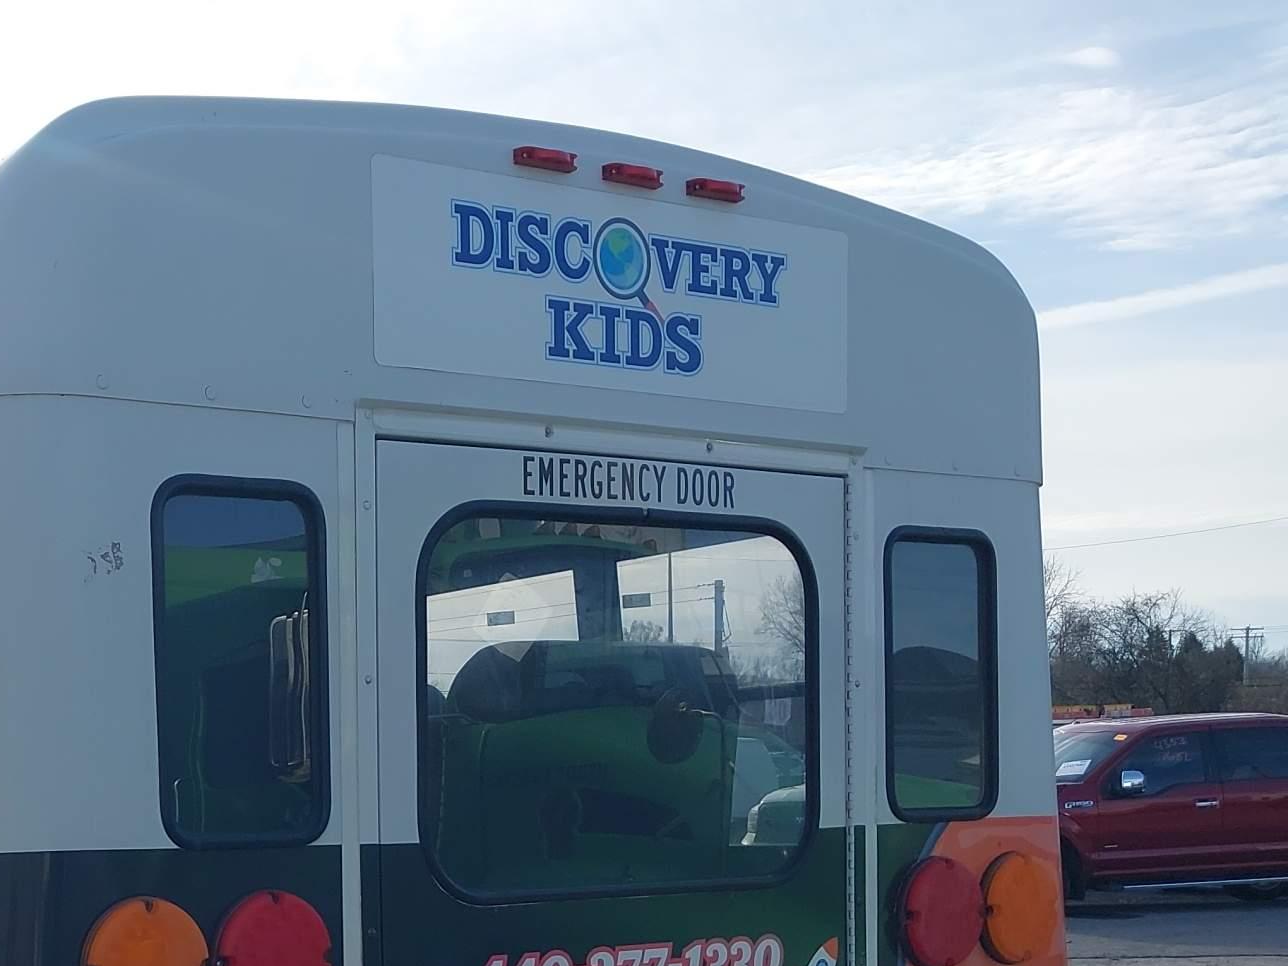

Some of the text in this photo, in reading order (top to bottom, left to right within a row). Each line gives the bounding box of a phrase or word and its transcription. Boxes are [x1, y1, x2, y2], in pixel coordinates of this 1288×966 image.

[544, 295, 705, 376] KIDS
[523, 456, 735, 509] EMERGENCY DOOR
